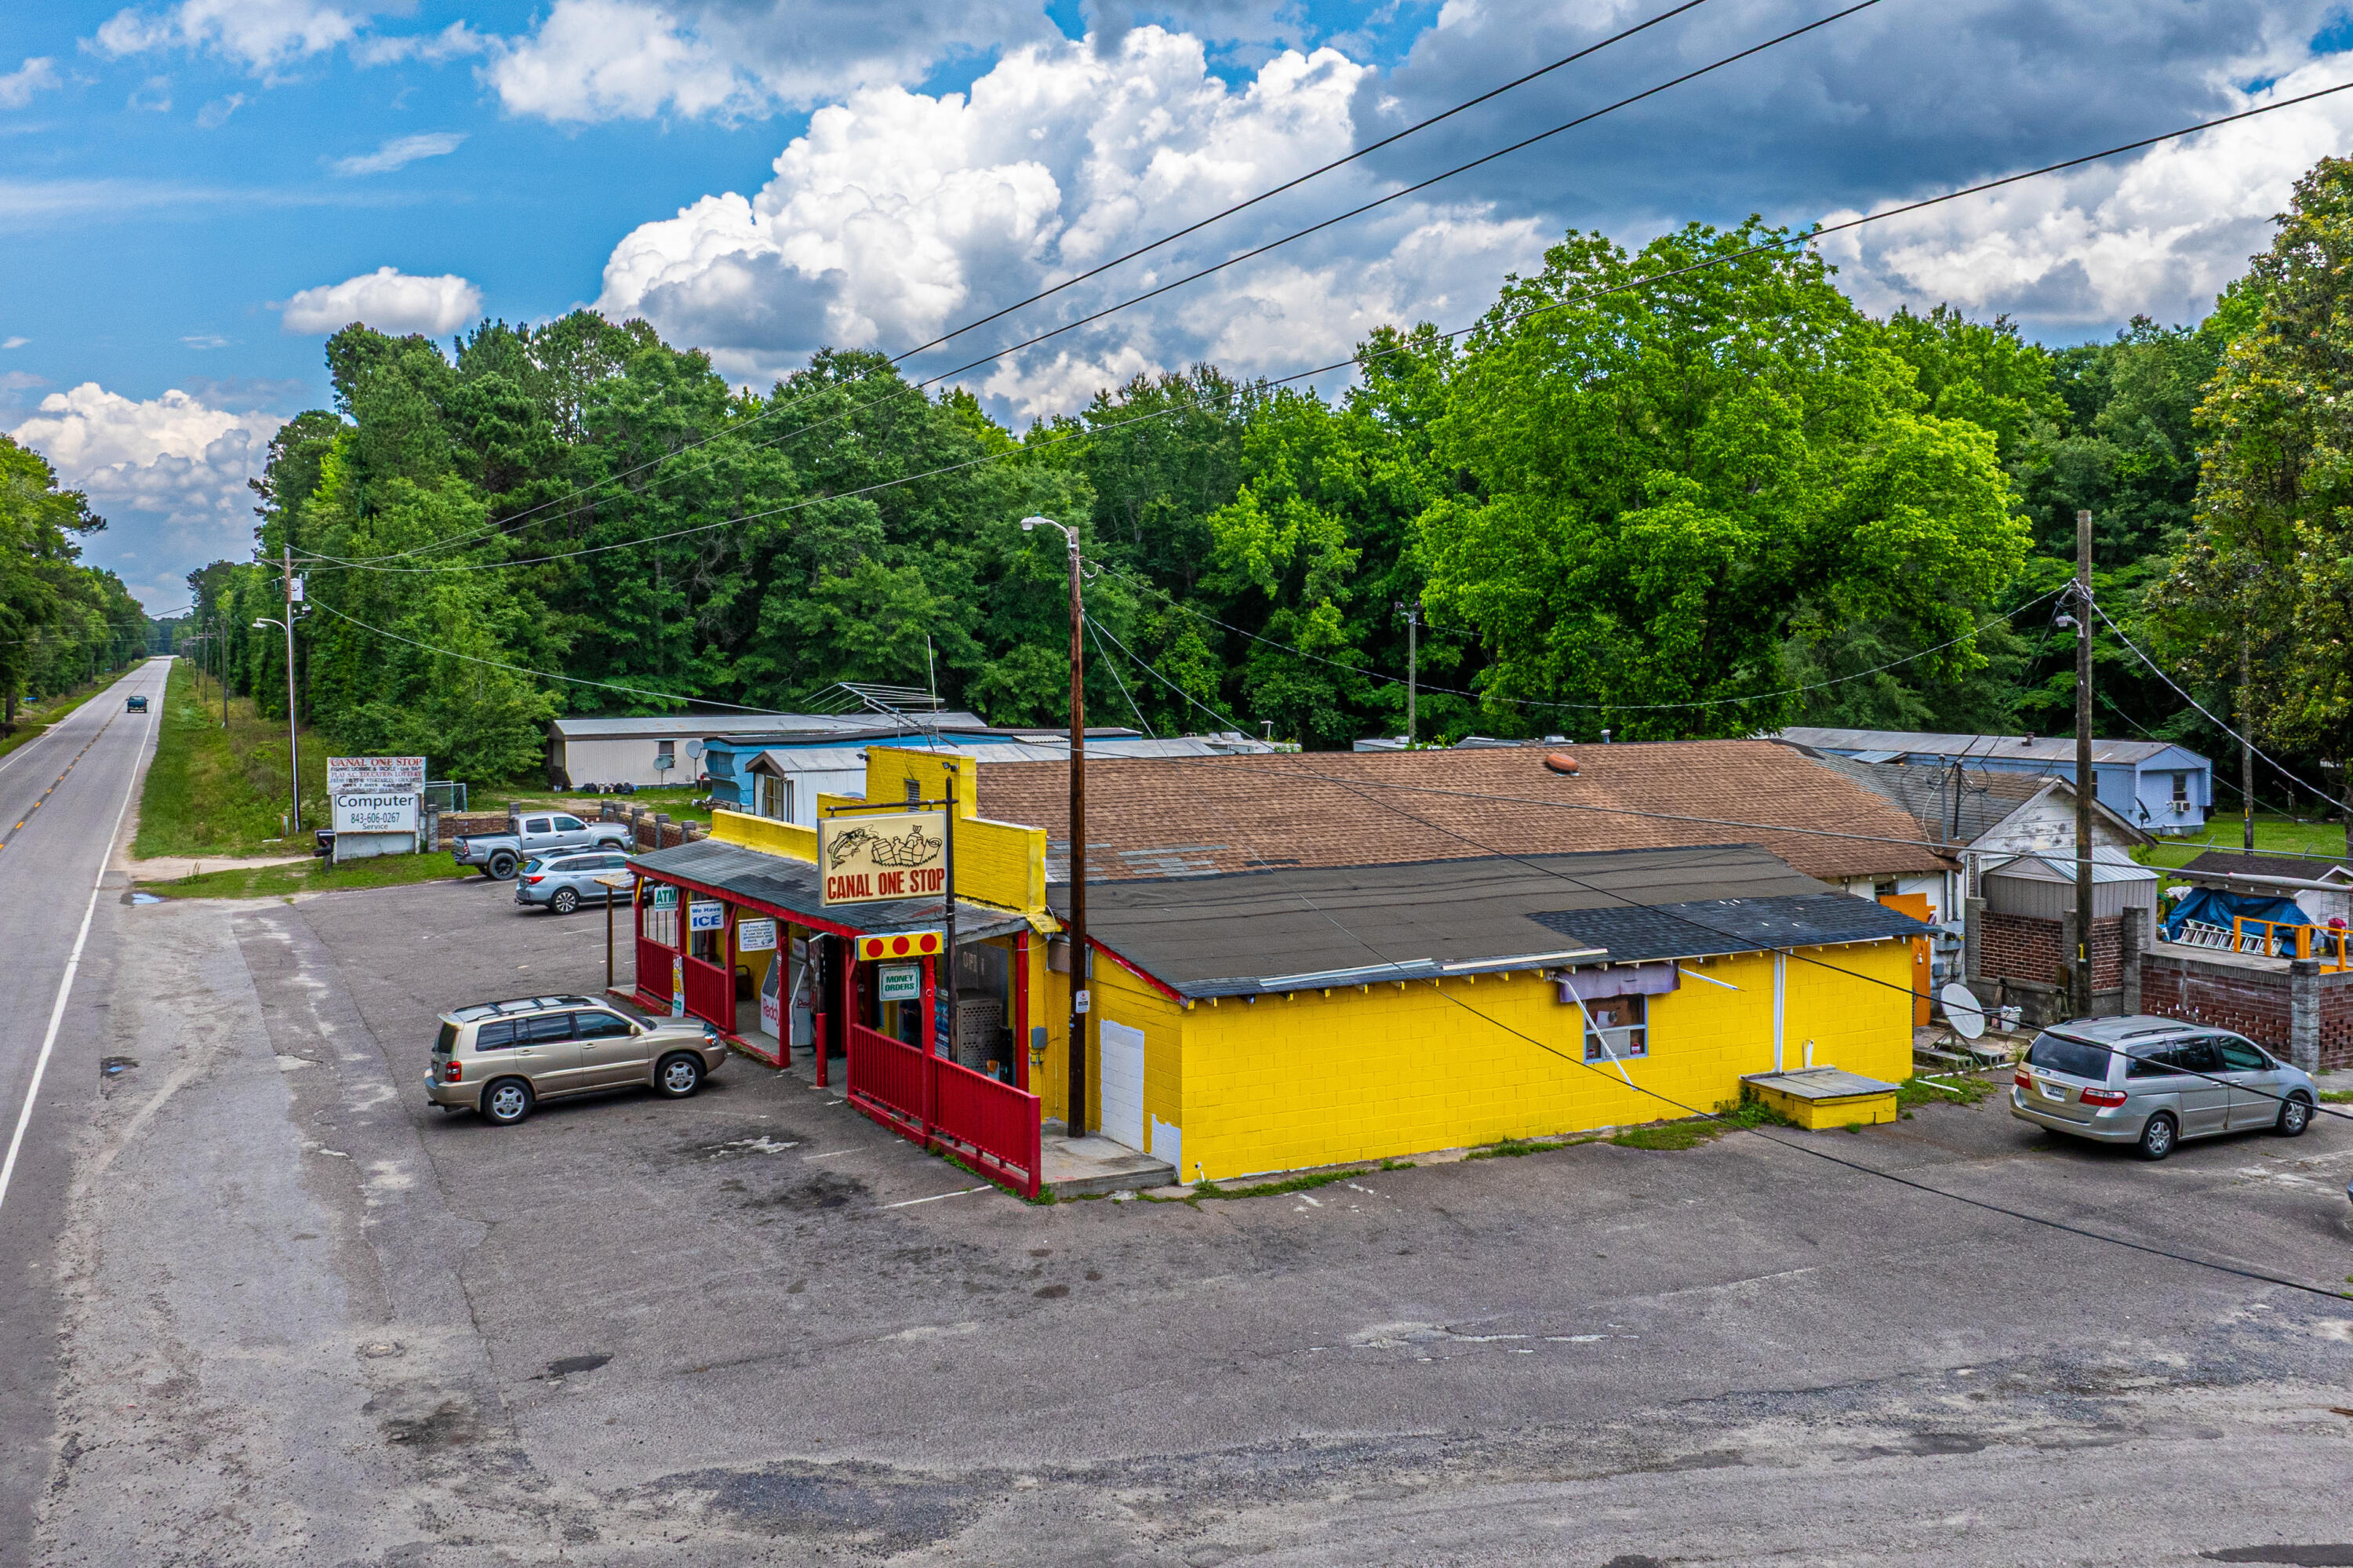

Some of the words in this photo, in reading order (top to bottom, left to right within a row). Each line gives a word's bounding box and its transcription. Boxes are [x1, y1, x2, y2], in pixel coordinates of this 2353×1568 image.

[397, 758, 422, 766] STOP
[337, 795, 414, 809] Computer
[351, 812, 400, 824] 843-606-0267
[827, 873, 873, 900] CANAL
[878, 871, 904, 896] ONE
[910, 868, 945, 893] STOP
[656, 889, 678, 903] ATM
[693, 914, 721, 927] ICE
[886, 974, 914, 984] MONEY
[885, 983, 915, 991] ORDERS
